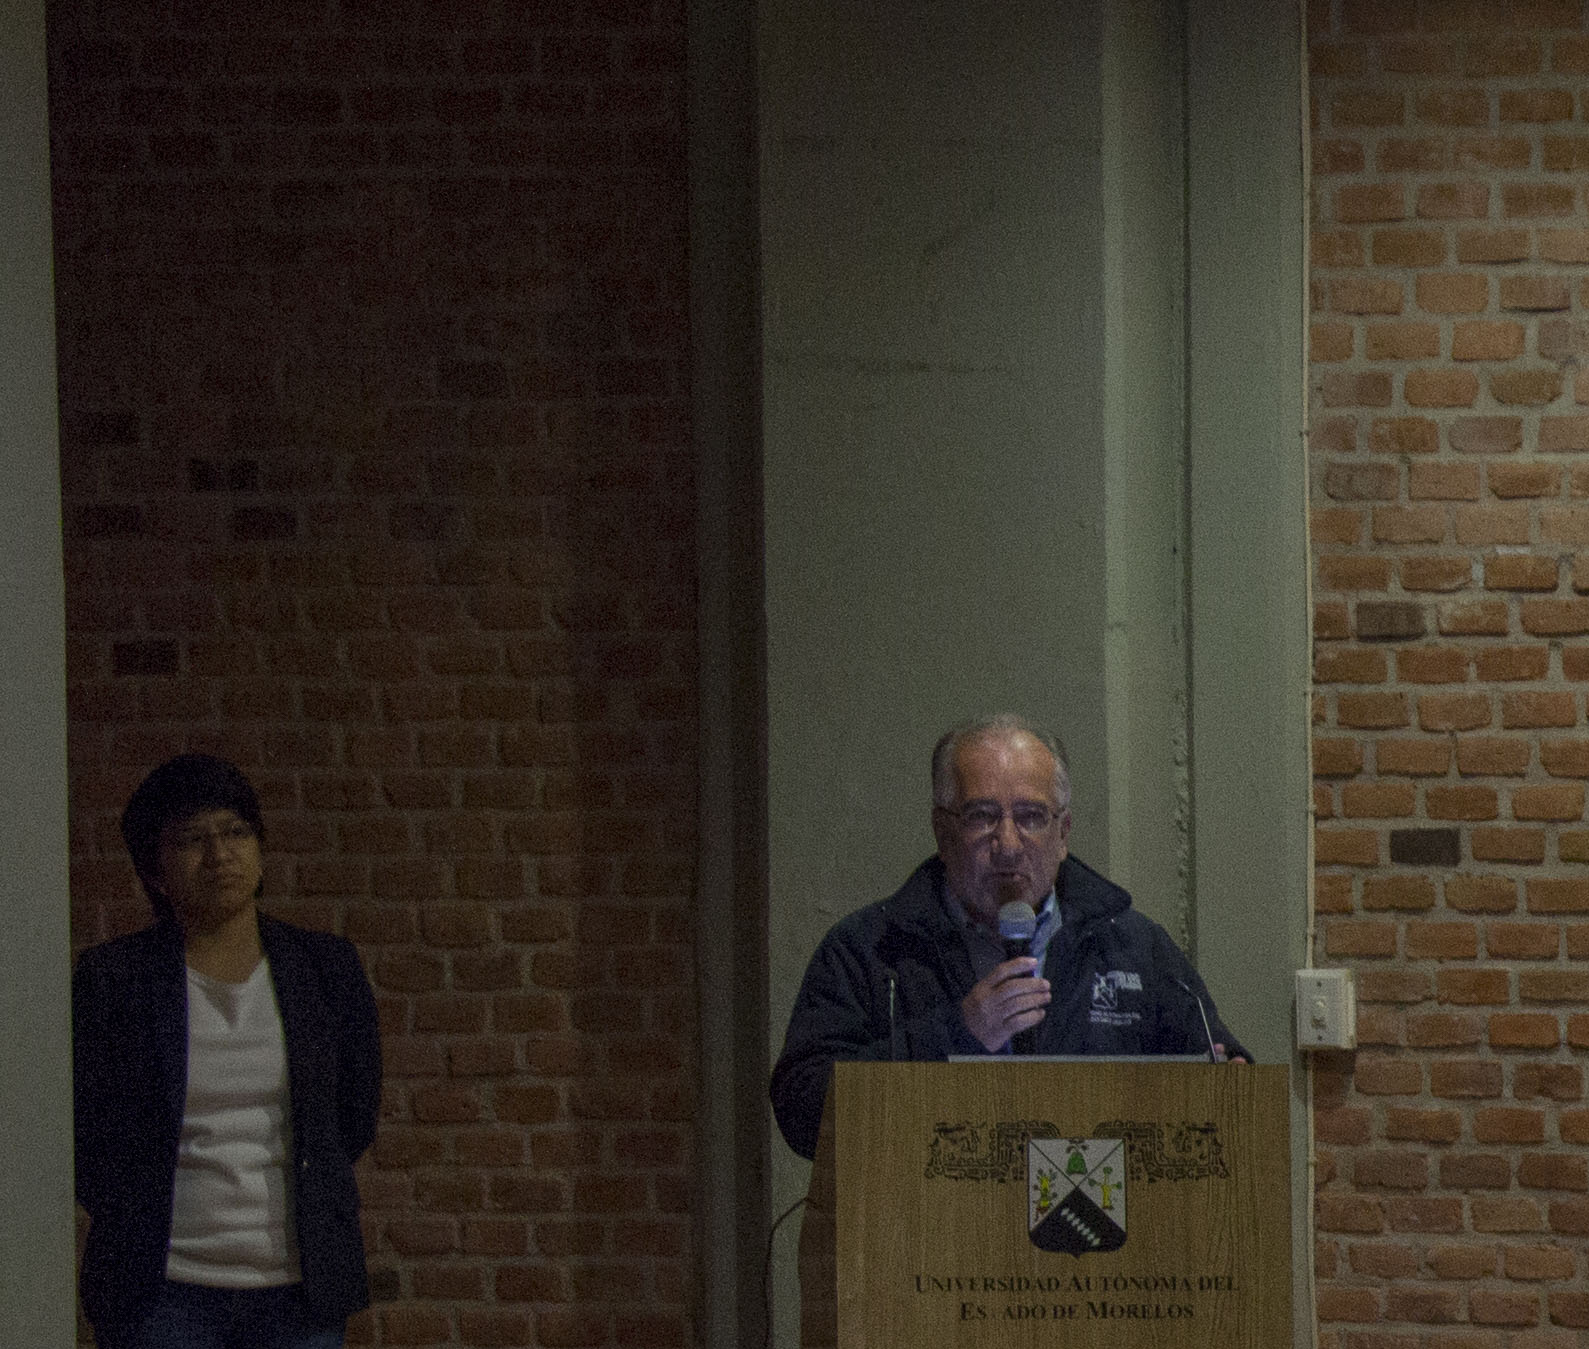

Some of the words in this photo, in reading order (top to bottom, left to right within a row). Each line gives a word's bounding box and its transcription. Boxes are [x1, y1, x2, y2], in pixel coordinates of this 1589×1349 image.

[914, 1274, 1061, 1293] UNIVERSIDAD
[1198, 1274, 1241, 1292] DEL
[1052, 1303, 1079, 1320] DE
[1086, 1300, 1196, 1321] MORELOS
